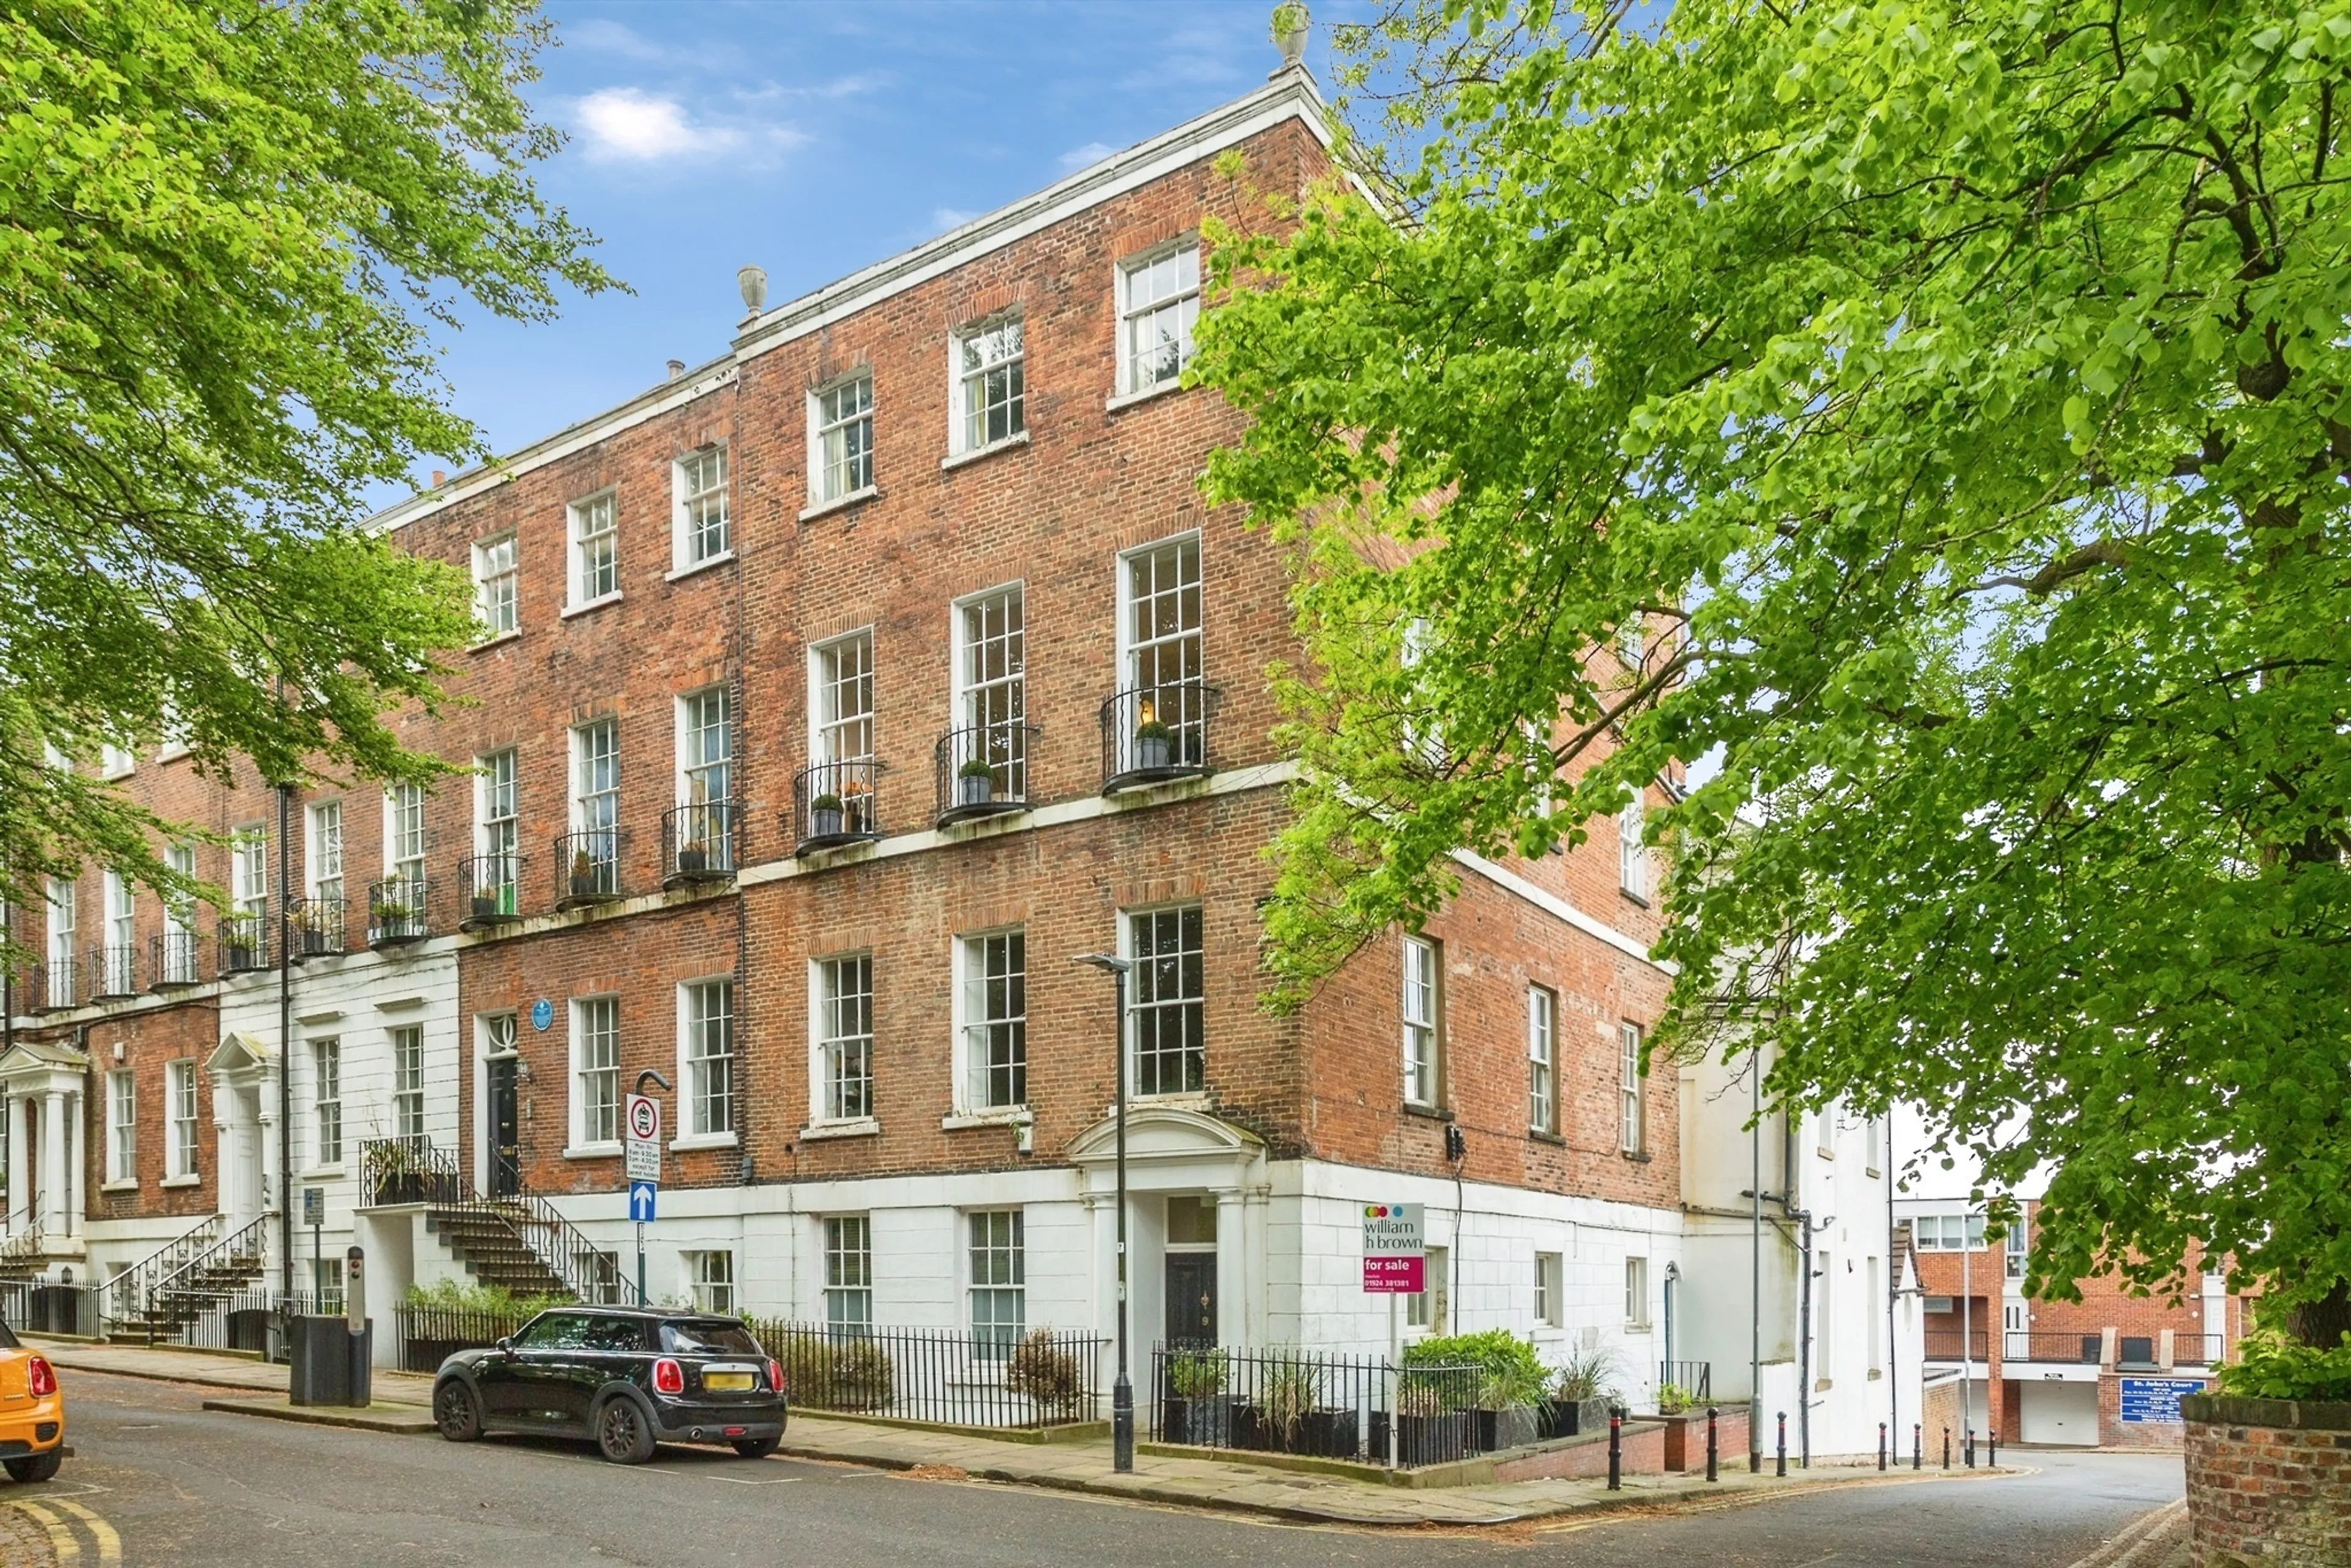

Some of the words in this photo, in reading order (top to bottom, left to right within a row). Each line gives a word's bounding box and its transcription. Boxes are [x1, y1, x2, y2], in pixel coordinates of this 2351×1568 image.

[1365, 1220, 1414, 1233] william
[1366, 1235, 1374, 1248] h
[1378, 1235, 1422, 1249] brown
[1365, 1259, 1383, 1270] for
[1385, 1259, 1409, 1270] sale
[1202, 1316, 1209, 1326] 9
